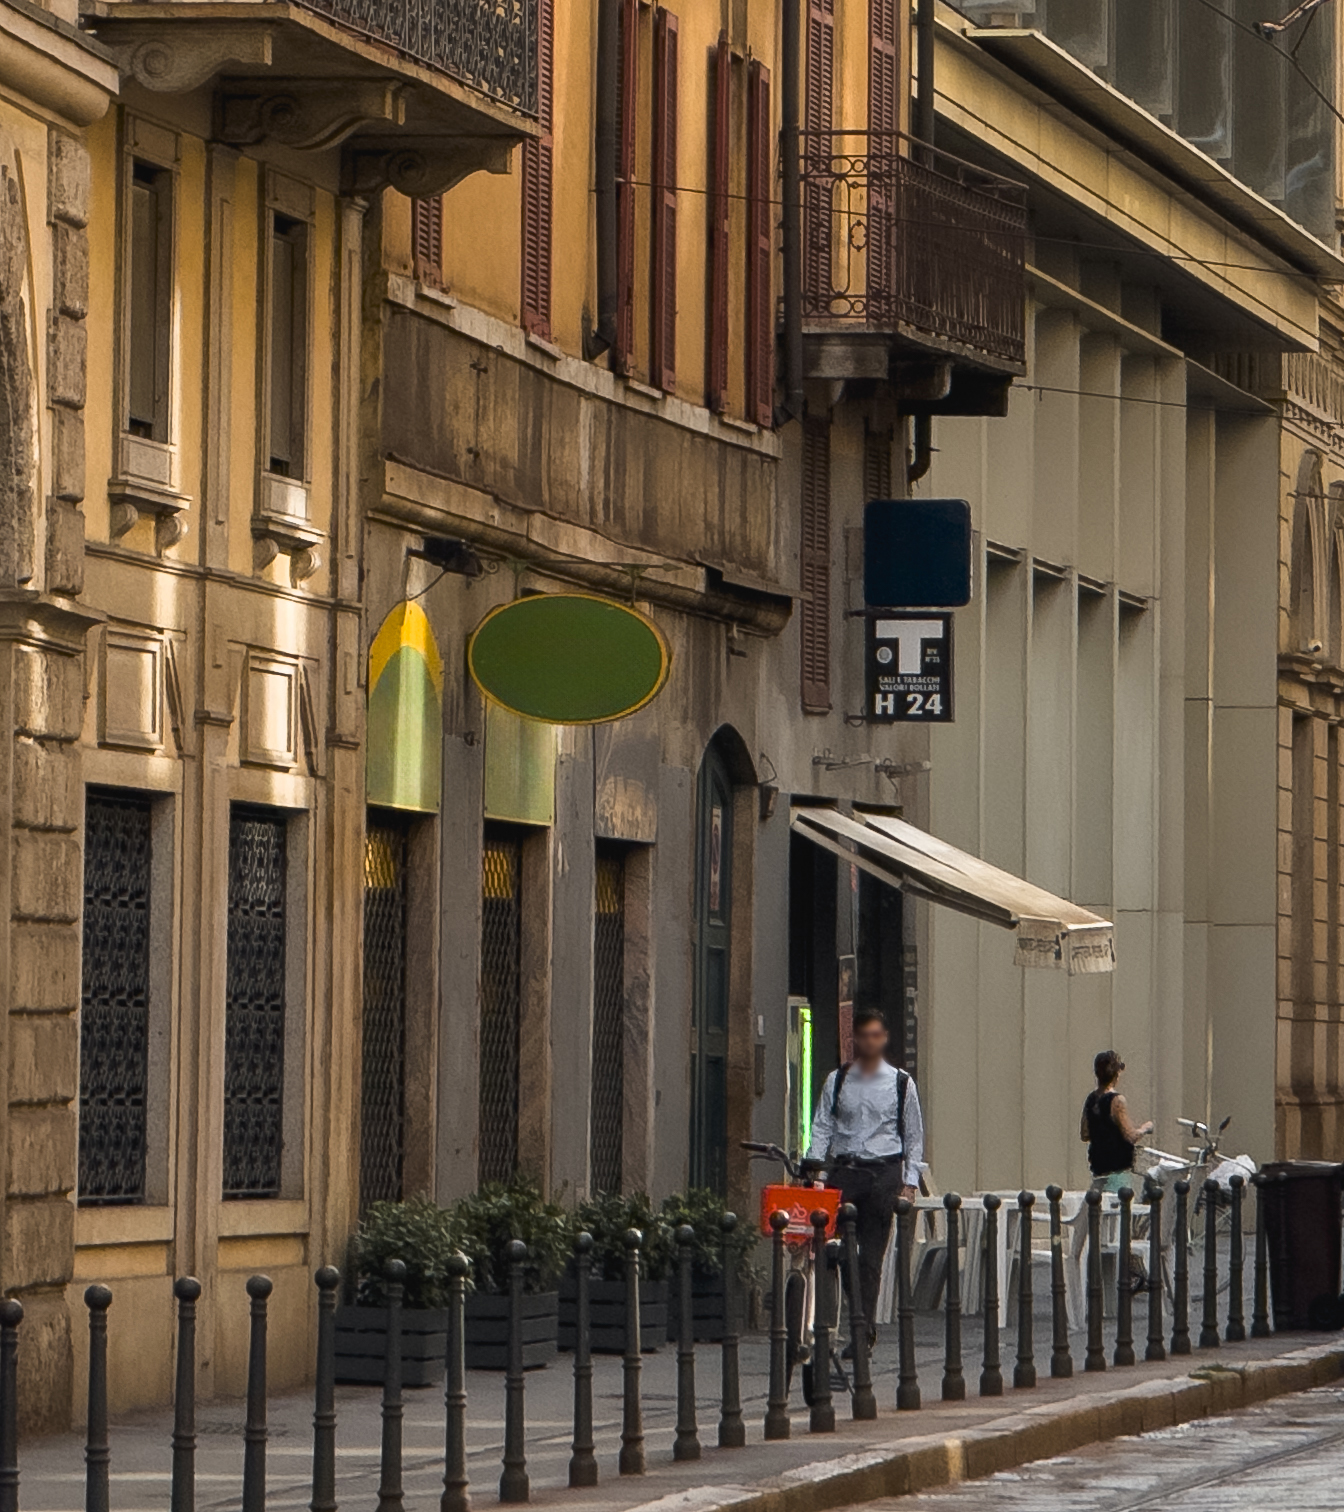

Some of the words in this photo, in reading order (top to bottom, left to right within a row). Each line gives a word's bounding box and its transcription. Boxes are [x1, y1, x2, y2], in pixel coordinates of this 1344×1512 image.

[875, 619, 944, 674] T
[903, 676, 941, 684] TABACCHI
[875, 693, 895, 715] H
[906, 693, 943, 715] 24
